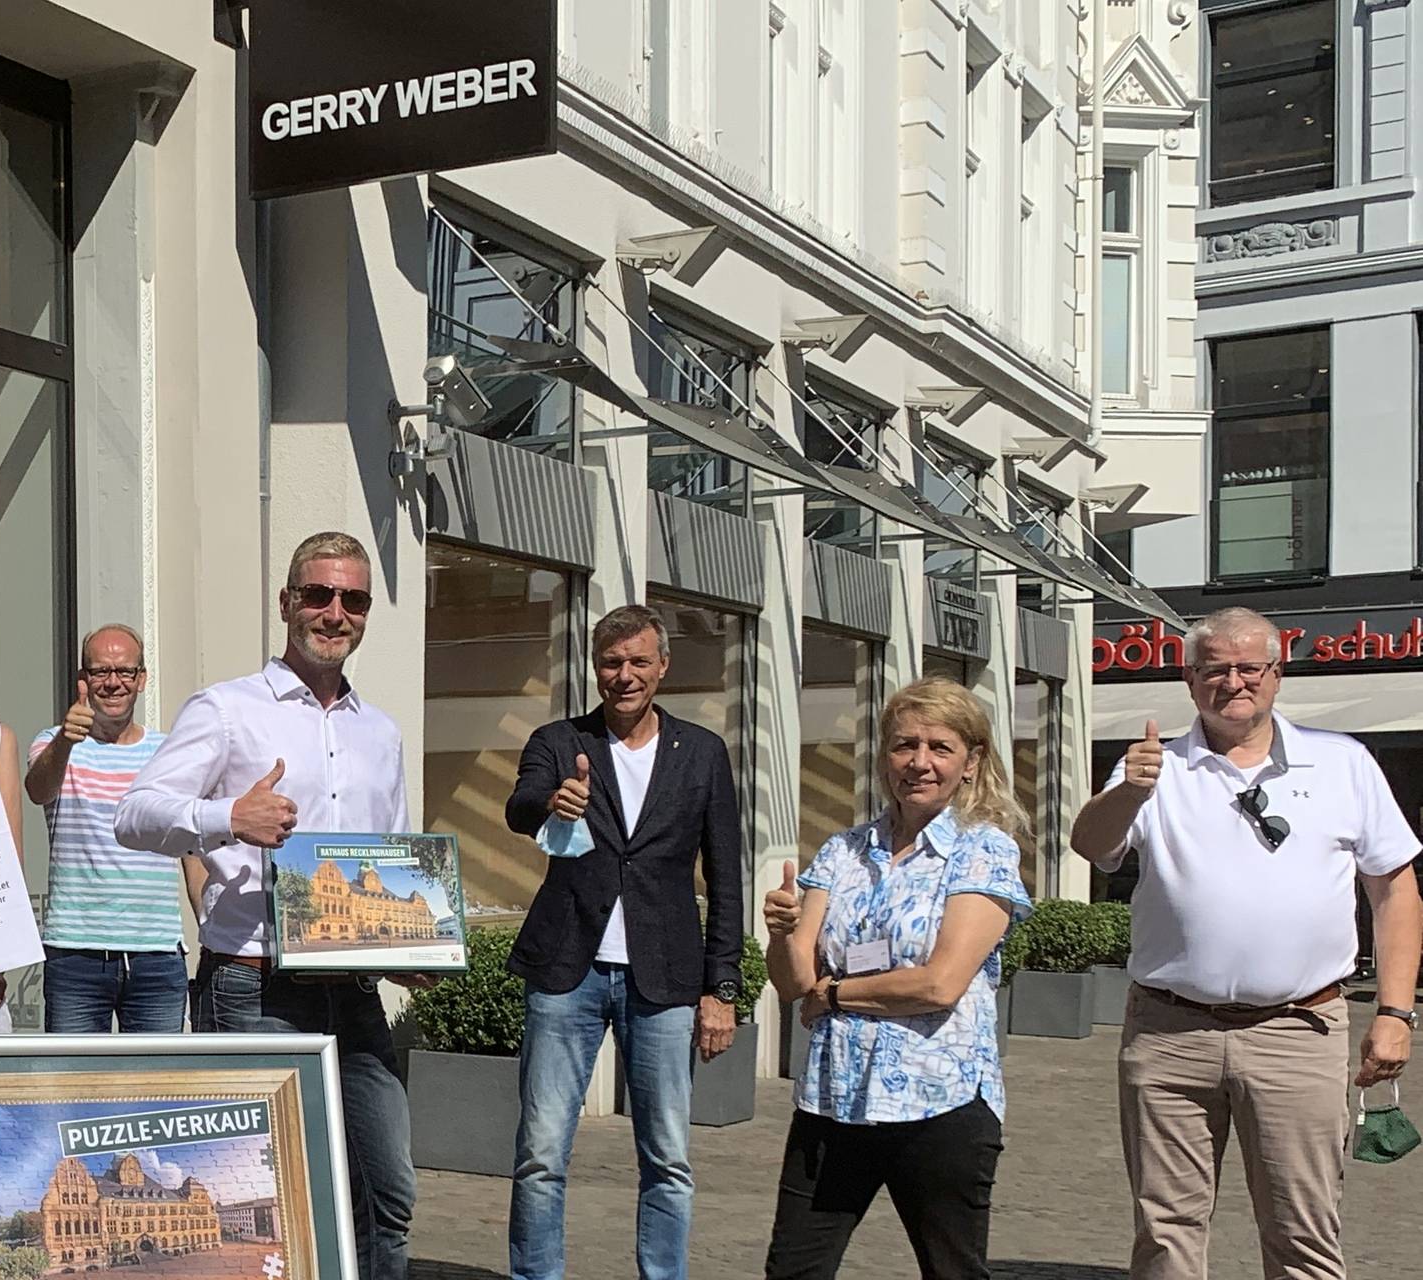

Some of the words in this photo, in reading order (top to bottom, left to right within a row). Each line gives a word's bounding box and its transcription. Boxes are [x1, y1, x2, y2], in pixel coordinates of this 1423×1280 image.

[261, 84, 389, 141] GERRY
[394, 59, 538, 118] WEBER
[320, 847, 349, 857] RATHAUS
[349, 847, 405, 857] RECKLINGHAUSEN
[67, 1108, 262, 1150] PUZZLE-VERKAUF
